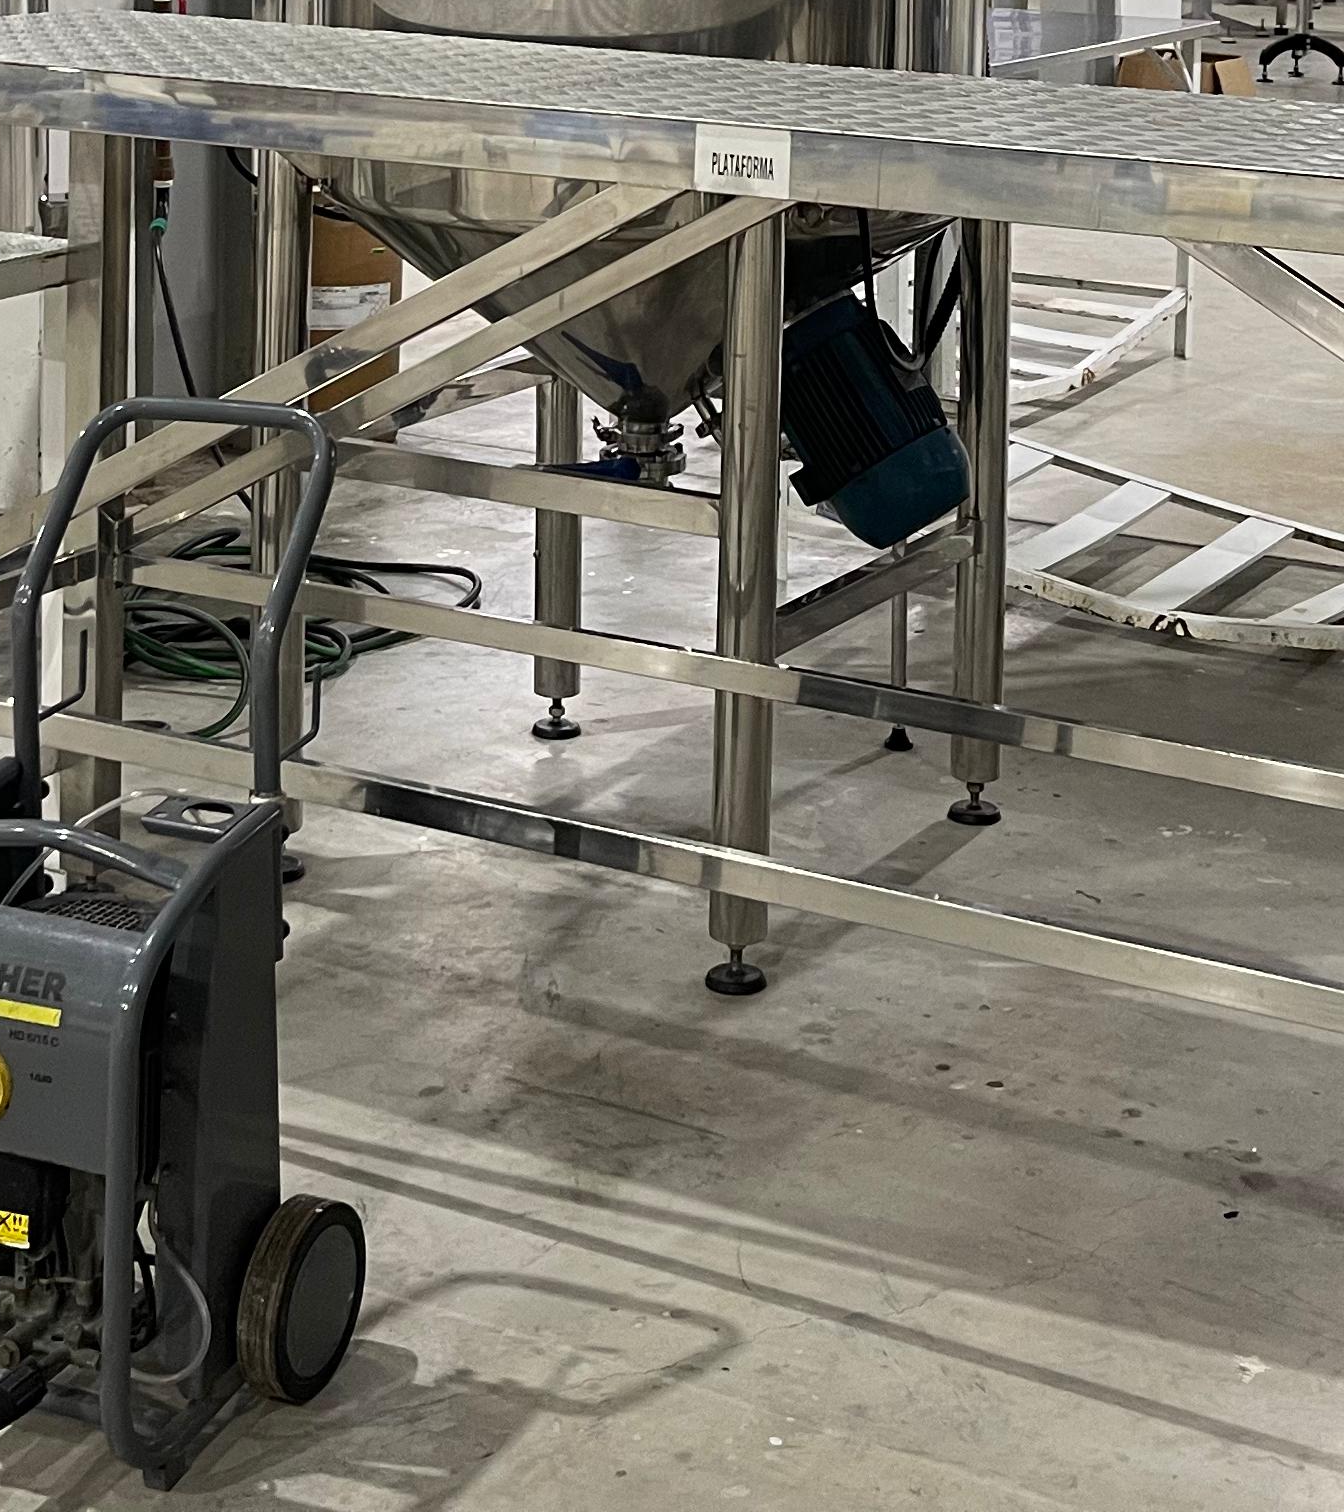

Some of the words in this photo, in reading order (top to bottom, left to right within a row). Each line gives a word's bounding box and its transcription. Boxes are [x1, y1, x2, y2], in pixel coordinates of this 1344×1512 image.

[711, 152, 774, 180] PLATAFORMA
[9, 1030, 25, 1041] HD
[50, 1036, 60, 1048] C
